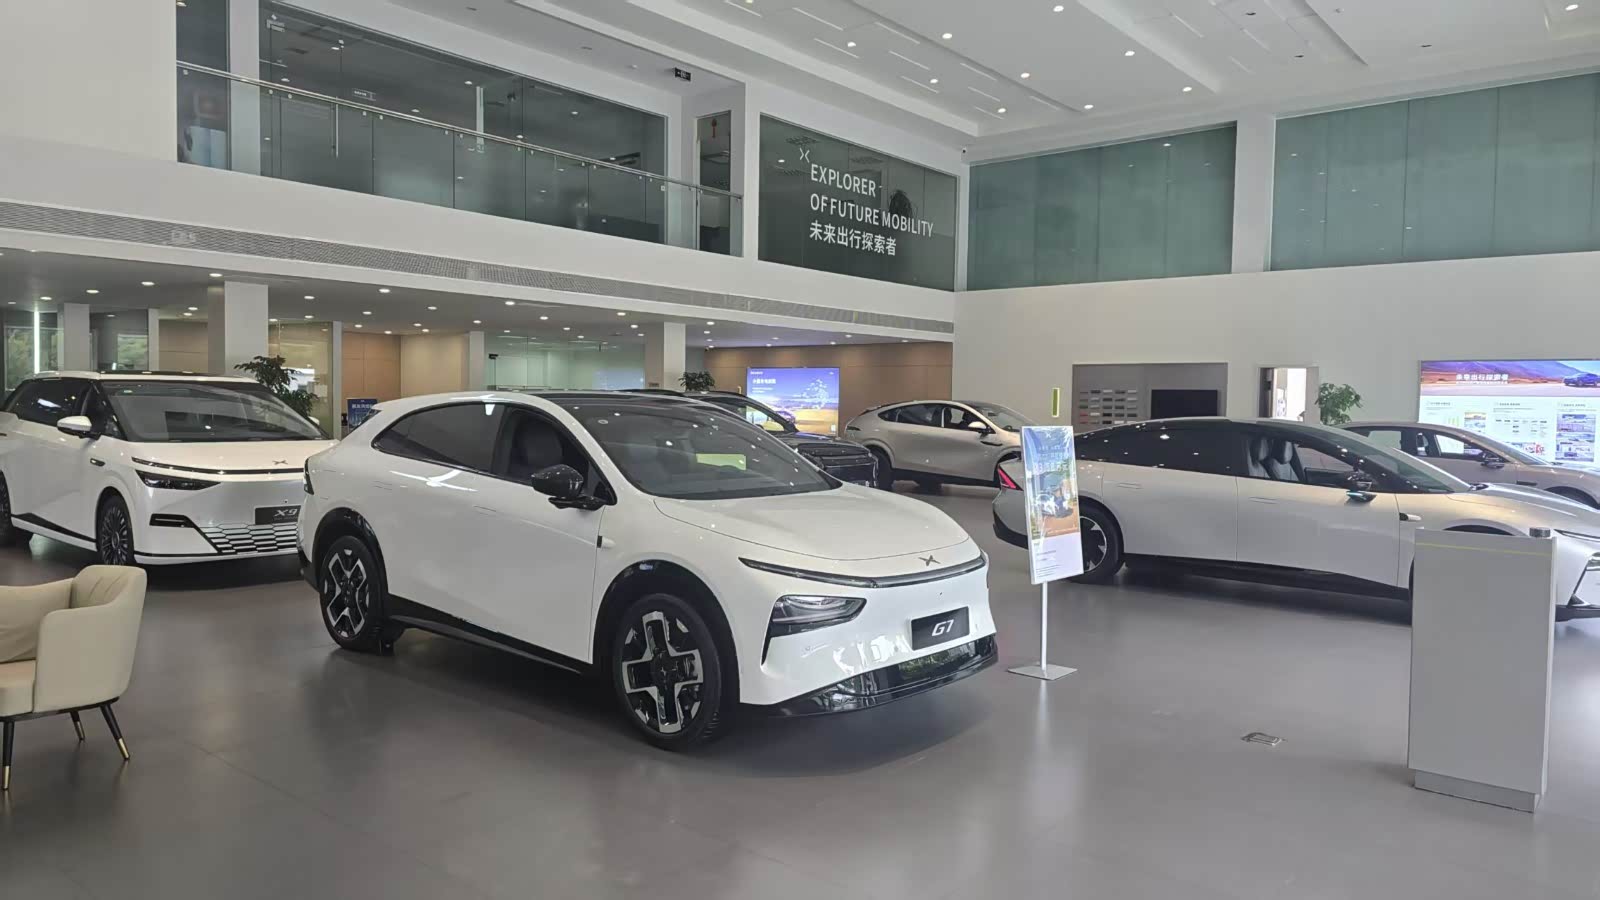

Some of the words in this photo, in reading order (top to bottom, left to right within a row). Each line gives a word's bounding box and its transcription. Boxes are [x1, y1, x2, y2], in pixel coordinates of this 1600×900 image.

[811, 163, 876, 197] EXPLORER
[810, 193, 829, 213] OF
[830, 198, 880, 226] FUTURE
[882, 211, 934, 237] MOBILITY
[809, 220, 897, 257] 未来出行探索者
[274, 508, 298, 517] X9
[931, 619, 954, 637] G7
